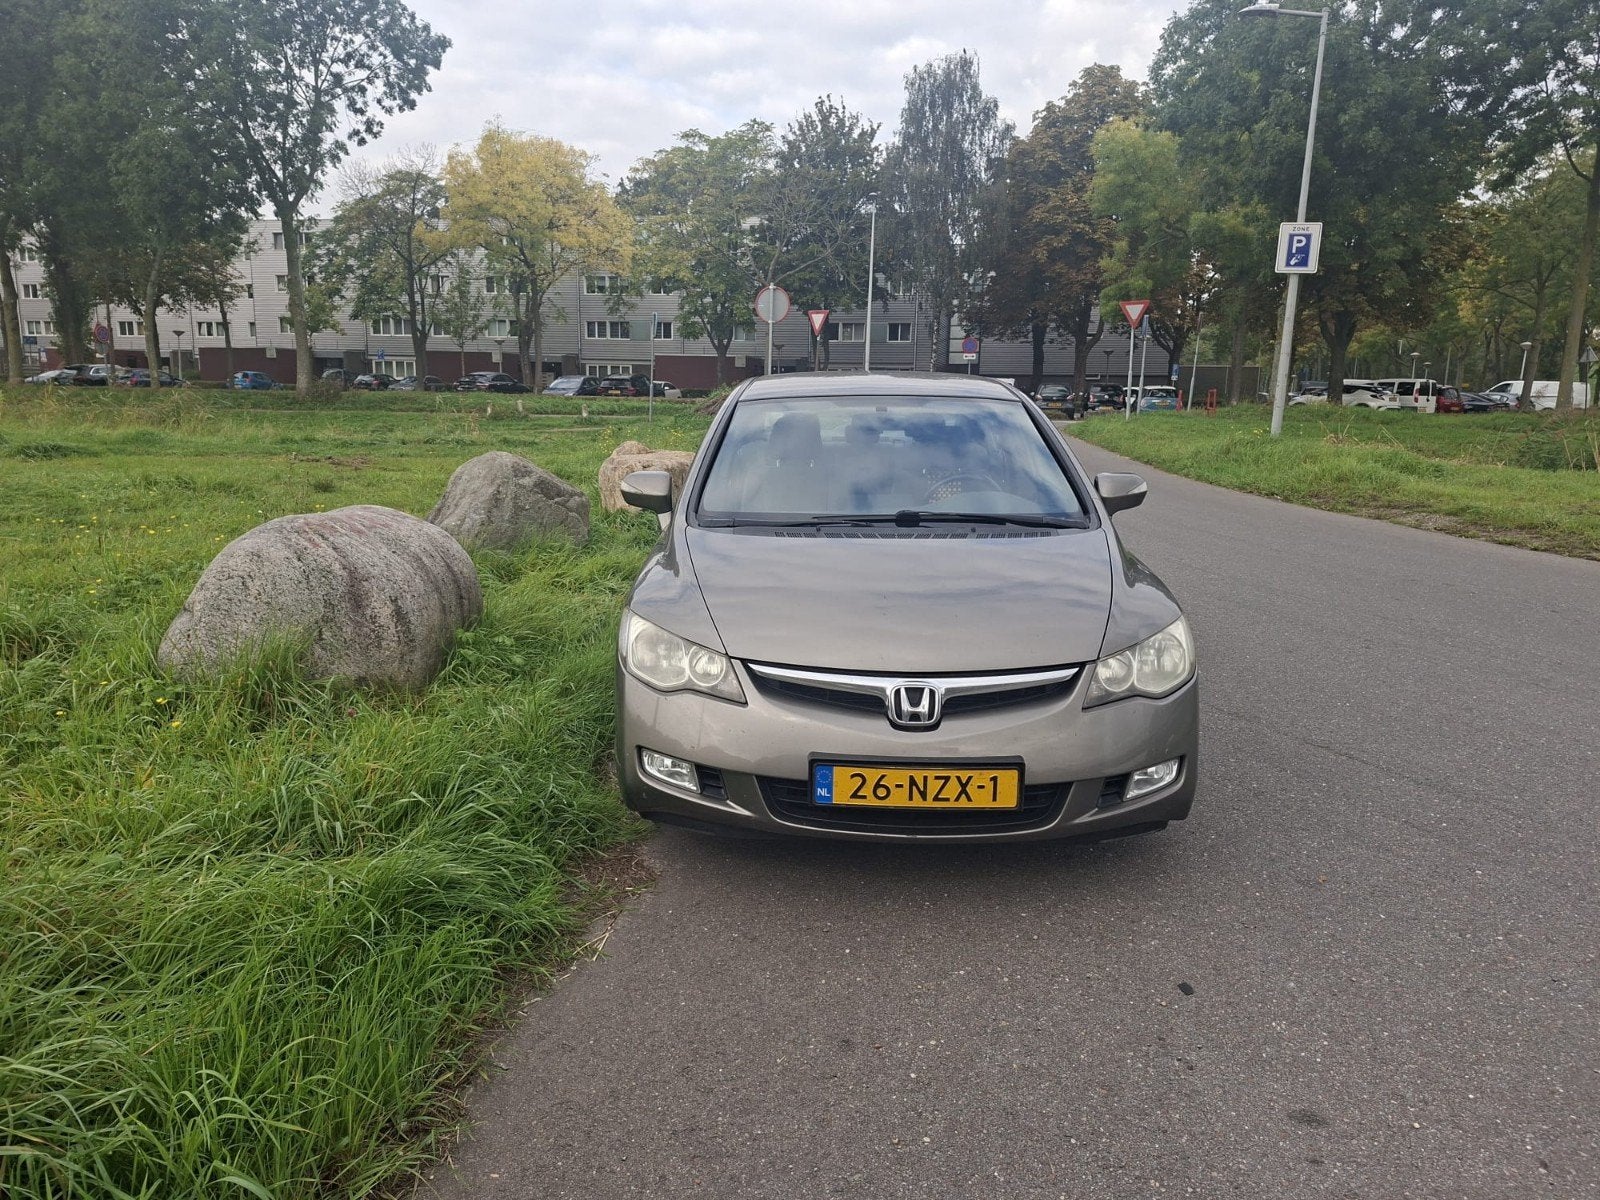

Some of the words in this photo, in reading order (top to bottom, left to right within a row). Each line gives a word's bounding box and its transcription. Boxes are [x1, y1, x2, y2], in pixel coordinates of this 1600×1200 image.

[1292, 235, 1307, 253] P
[817, 787, 831, 797] NL
[849, 772, 999, 802] 26-NZX-1
